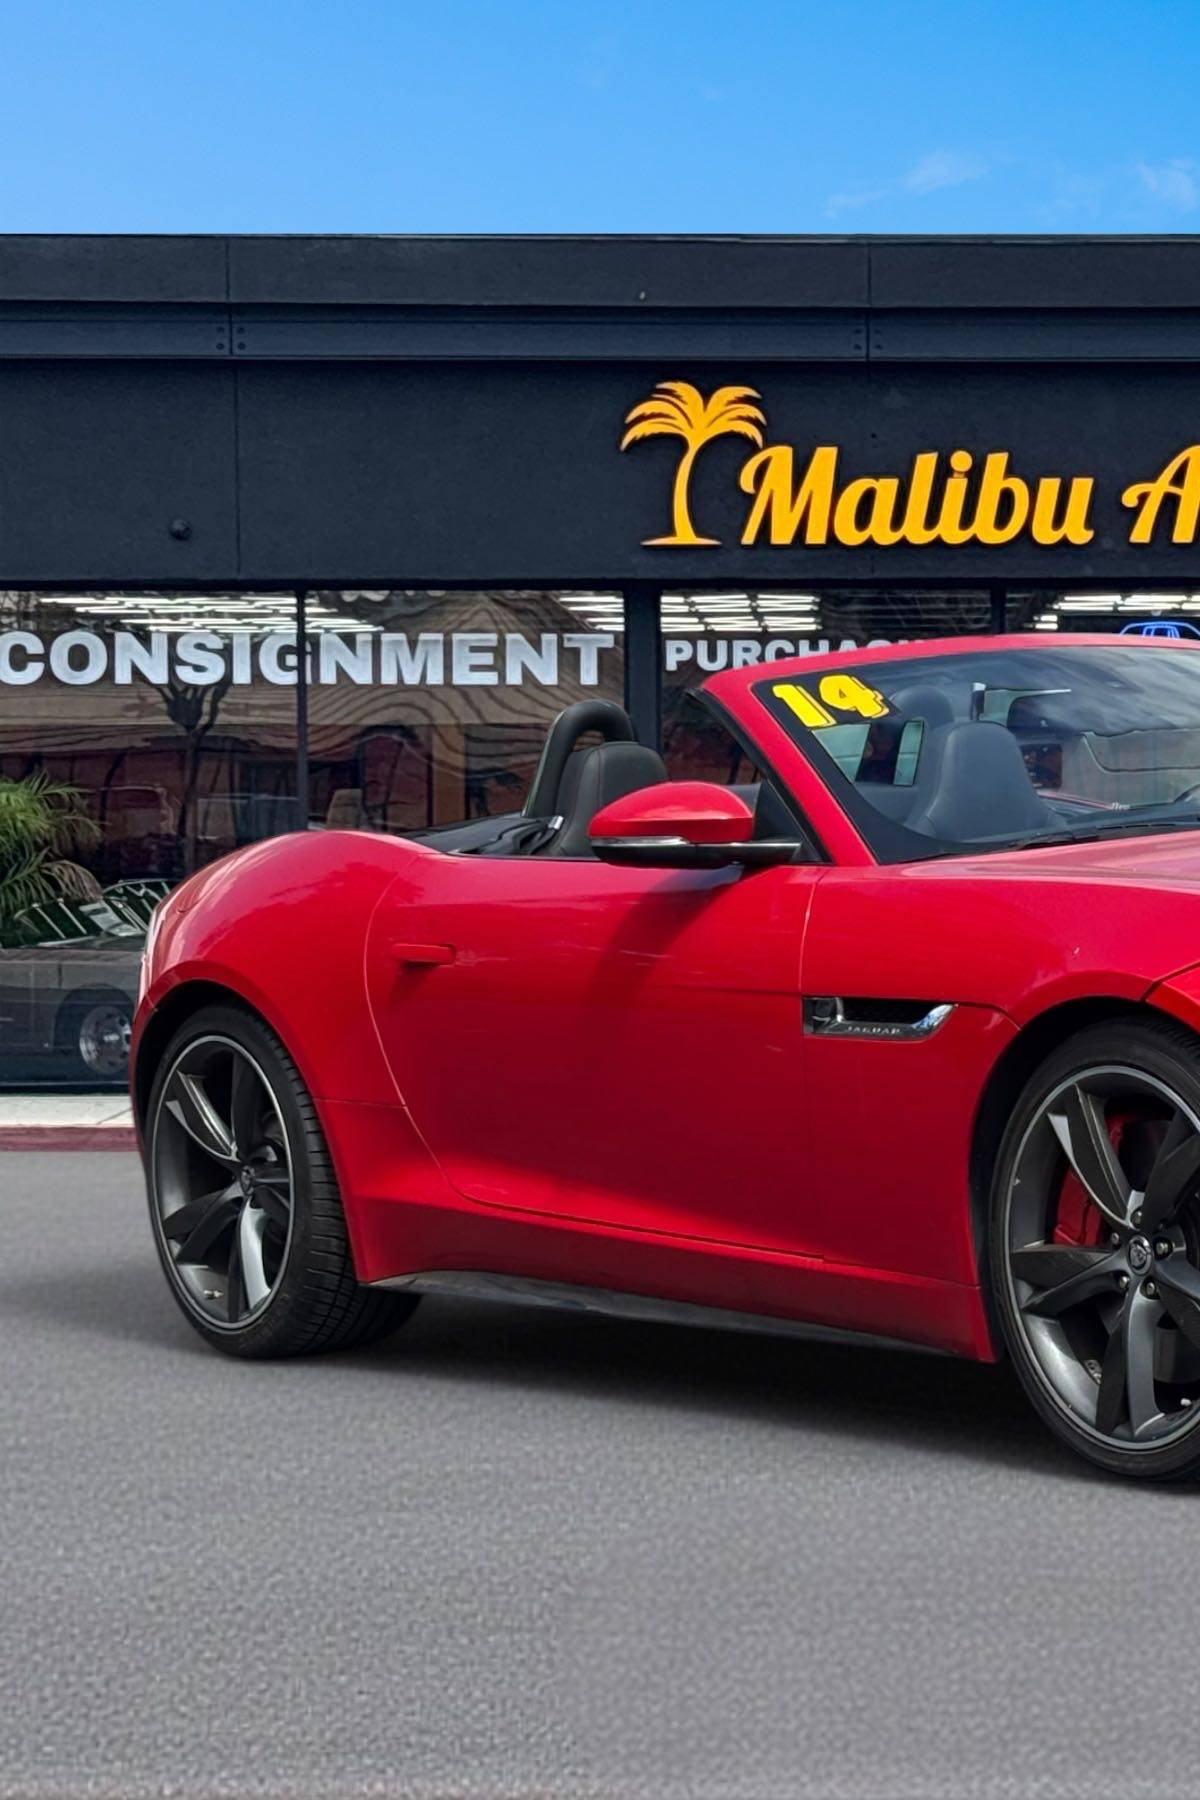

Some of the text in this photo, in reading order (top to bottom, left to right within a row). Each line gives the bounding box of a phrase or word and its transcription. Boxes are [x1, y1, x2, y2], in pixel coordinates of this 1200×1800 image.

[740, 445, 1095, 546] Malibu
[0, 630, 615, 686] CONSIGNMENT
[664, 638, 926, 672] PURCH
[772, 674, 890, 728] 14
